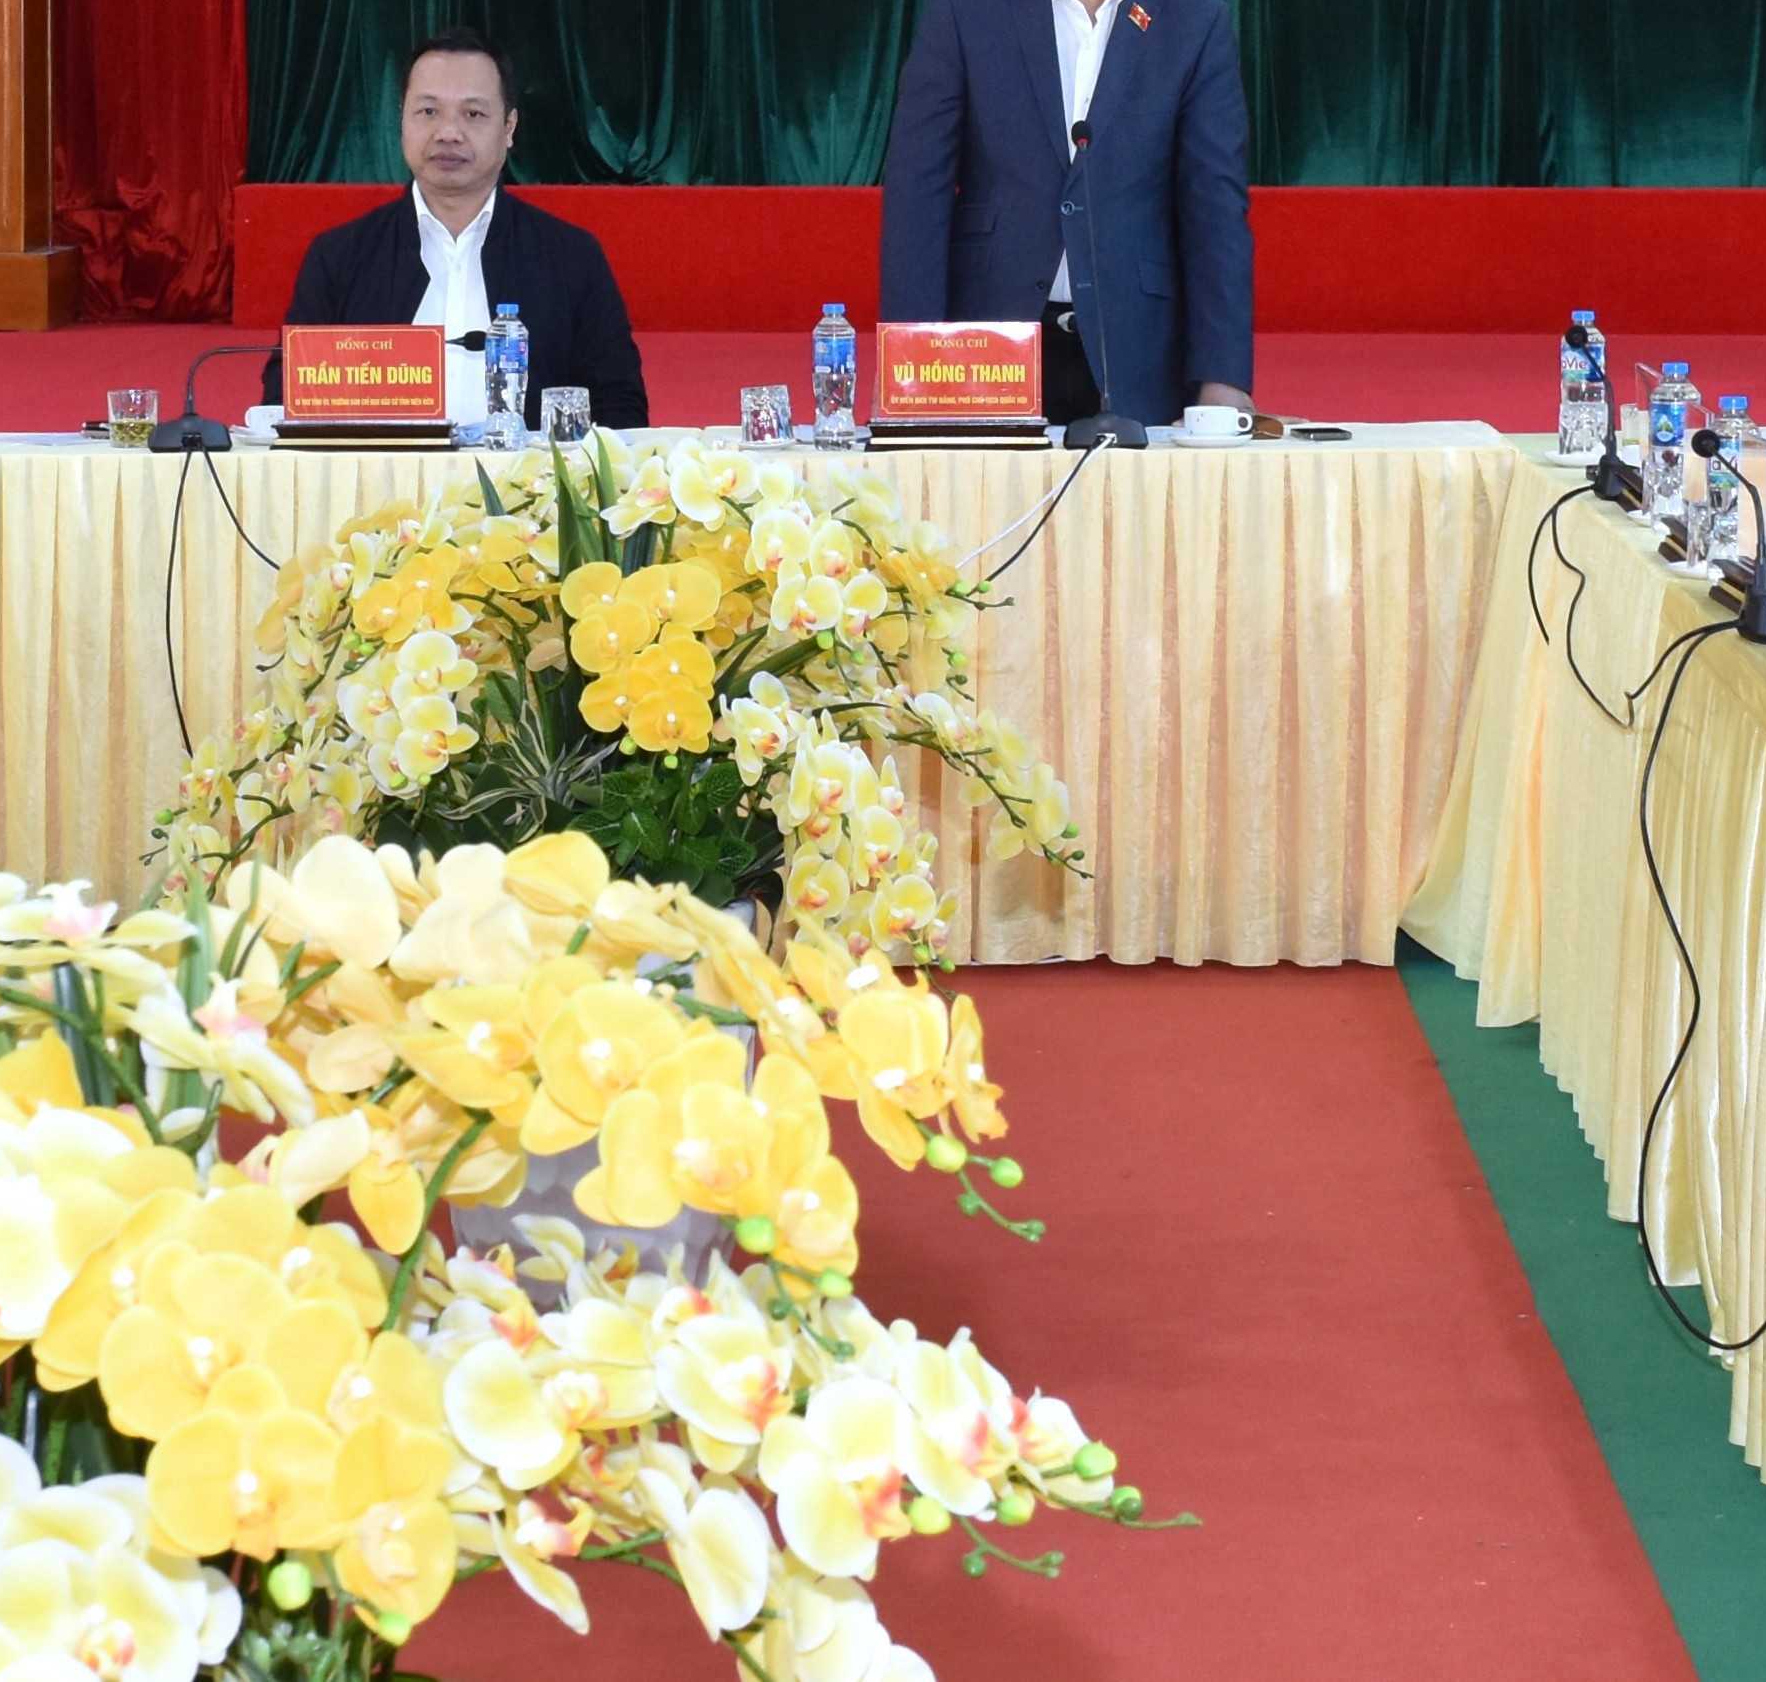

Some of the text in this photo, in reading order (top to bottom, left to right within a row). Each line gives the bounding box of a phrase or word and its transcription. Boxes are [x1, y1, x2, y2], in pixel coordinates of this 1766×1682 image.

[345, 361, 382, 385] TIẾN
[387, 363, 432, 385] DŨNG
[893, 359, 1026, 384] VŨ HỒNG THANH
[1561, 356, 1587, 370] aVie
